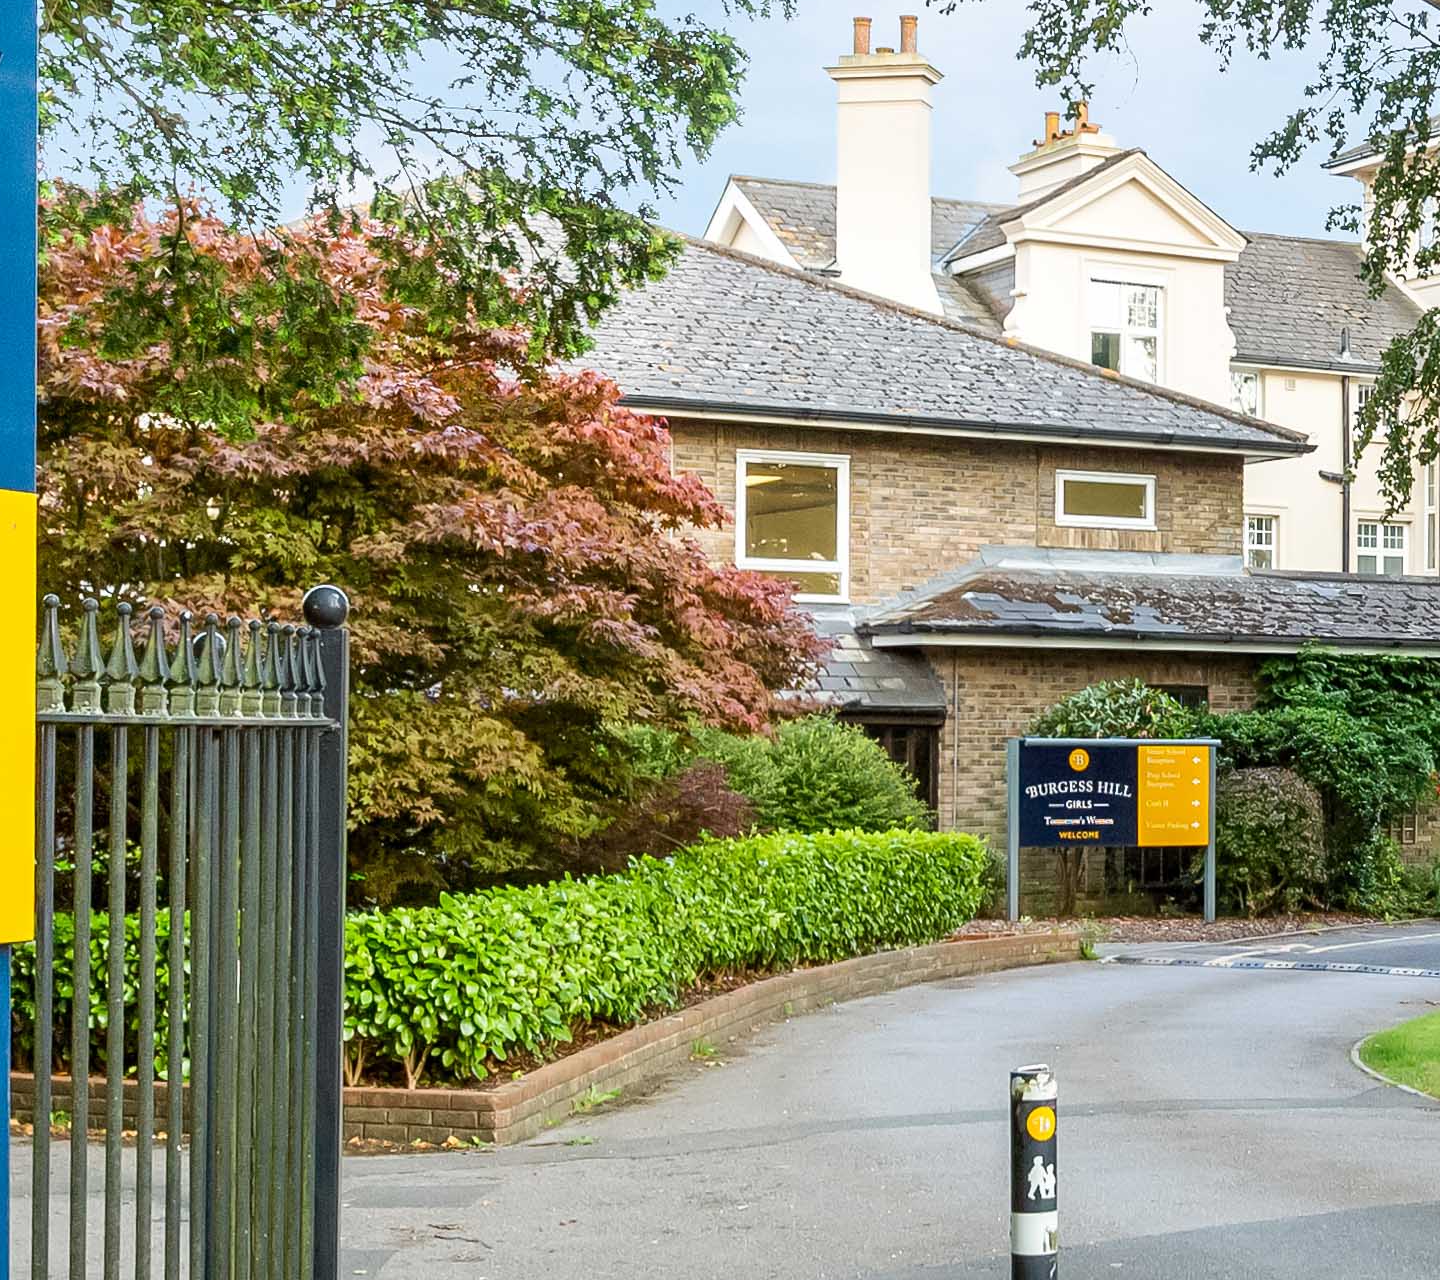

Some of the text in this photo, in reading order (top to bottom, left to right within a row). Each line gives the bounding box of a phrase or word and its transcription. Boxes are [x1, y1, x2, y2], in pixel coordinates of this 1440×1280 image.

[1025, 780, 1094, 799] BURGESS
[1097, 780, 1133, 798] HILL
[1065, 800, 1093, 809] GIRLS
[1059, 831, 1100, 839] WELCOME
